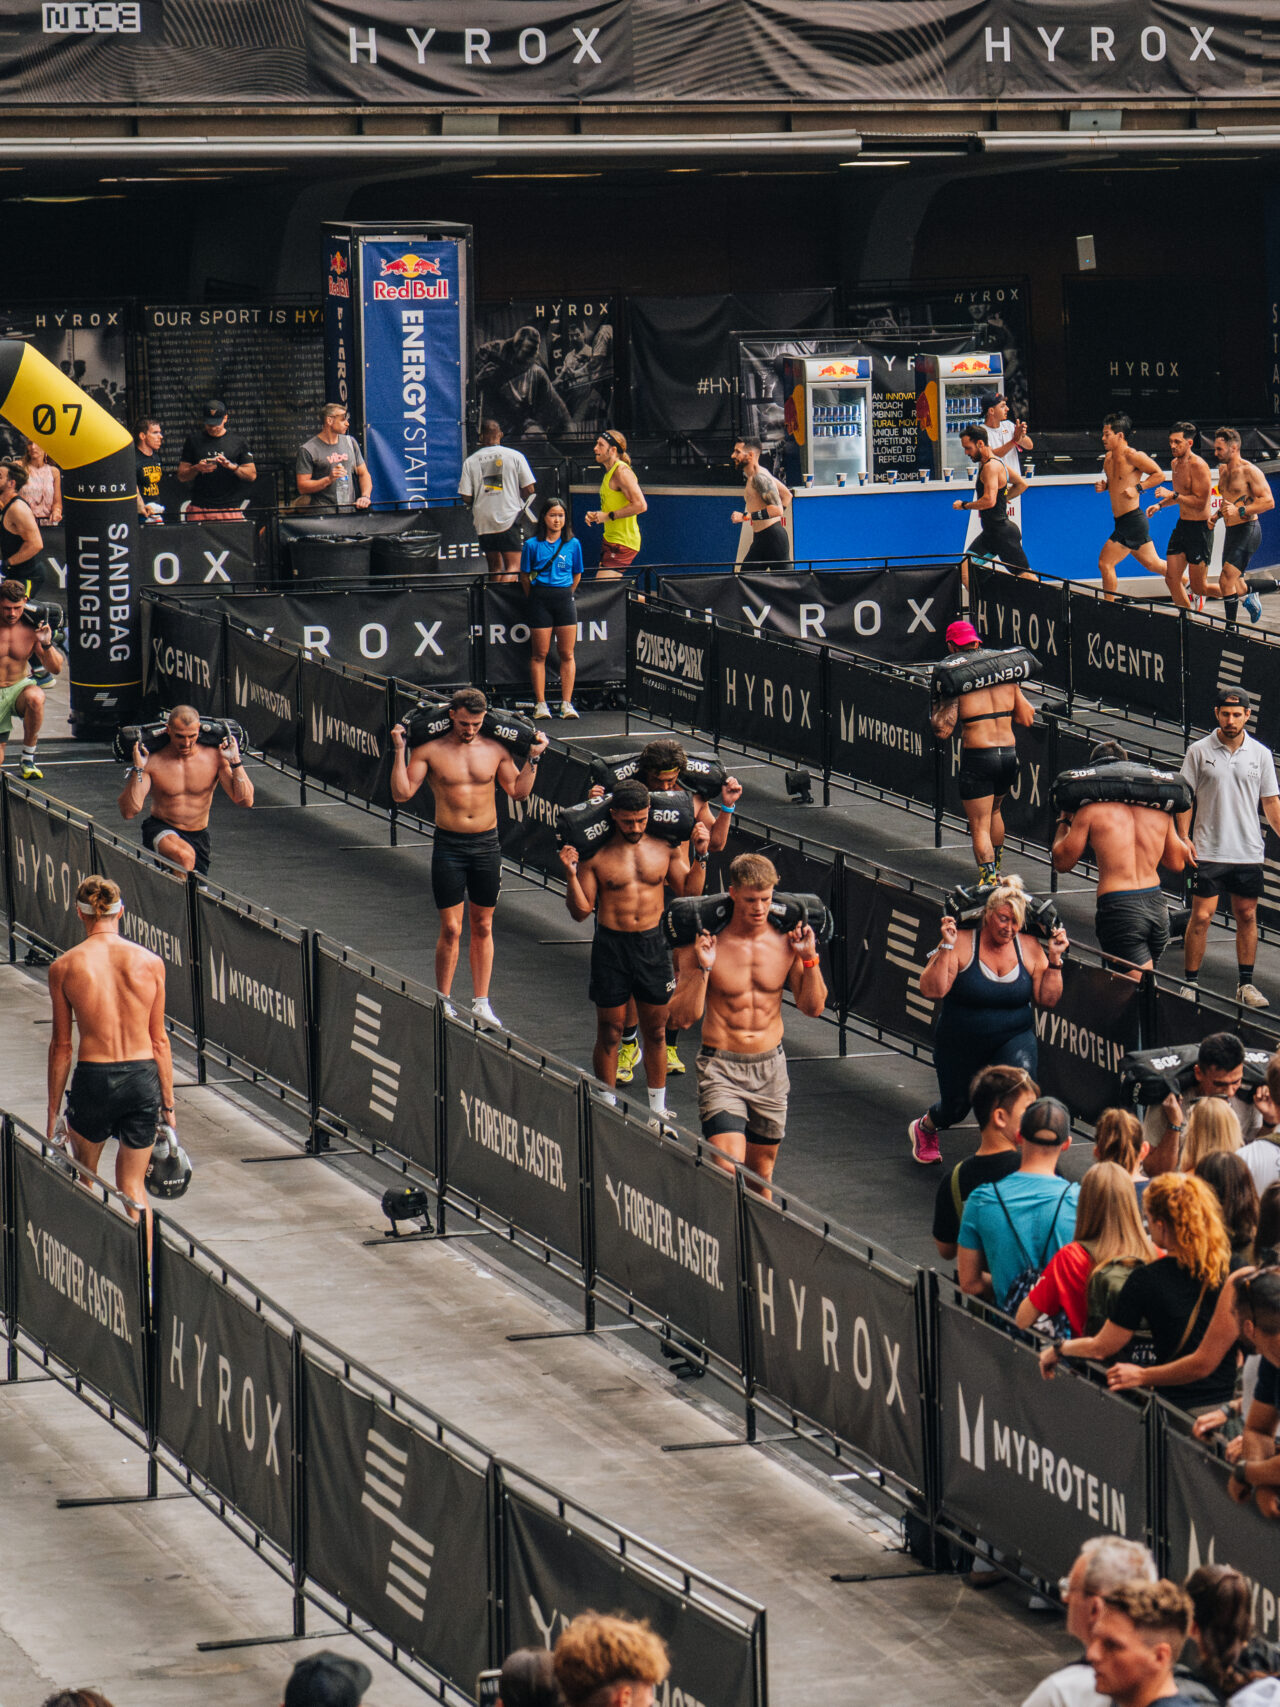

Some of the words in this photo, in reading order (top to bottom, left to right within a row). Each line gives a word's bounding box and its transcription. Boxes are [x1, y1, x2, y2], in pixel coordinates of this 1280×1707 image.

[349, 27, 602, 64] HYROX
[984, 26, 1216, 63] HYROX
[374, 281, 411, 299] Red
[412, 281, 448, 299] Bull
[536, 303, 609, 317] HYROX
[954, 289, 1019, 303] HYROX
[36, 312, 118, 328] HYROX
[154, 311, 191, 326] OUR
[200, 309, 261, 325] SPORT
[269, 310, 287, 323] IS
[1110, 361, 1180, 377] HYROX
[33, 404, 82, 436] 07
[78, 483, 126, 493] HYROX
[78, 535, 100, 649] LUNGES
[108, 523, 130, 662] SANDBAG
[978, 599, 1058, 656] HYROX
[165, 646, 212, 689] CENTR
[636, 629, 676, 672] FITNESS
[678, 642, 704, 681] PARK
[1104, 643, 1164, 683] CENTR
[726, 667, 812, 729] HYROX
[326, 714, 381, 758] MYPROTEIN
[858, 714, 922, 757] MYPROTEIN
[122, 910, 182, 967] MYPROTEIN
[229, 969, 296, 1029] MYPROTEIN
[1034, 1007, 1124, 1074] MYPROTEIN
[757, 1262, 906, 1414] HYROX
[170, 1314, 282, 1476] HYROX
[993, 1419, 1127, 1536] MYPROTEIN
